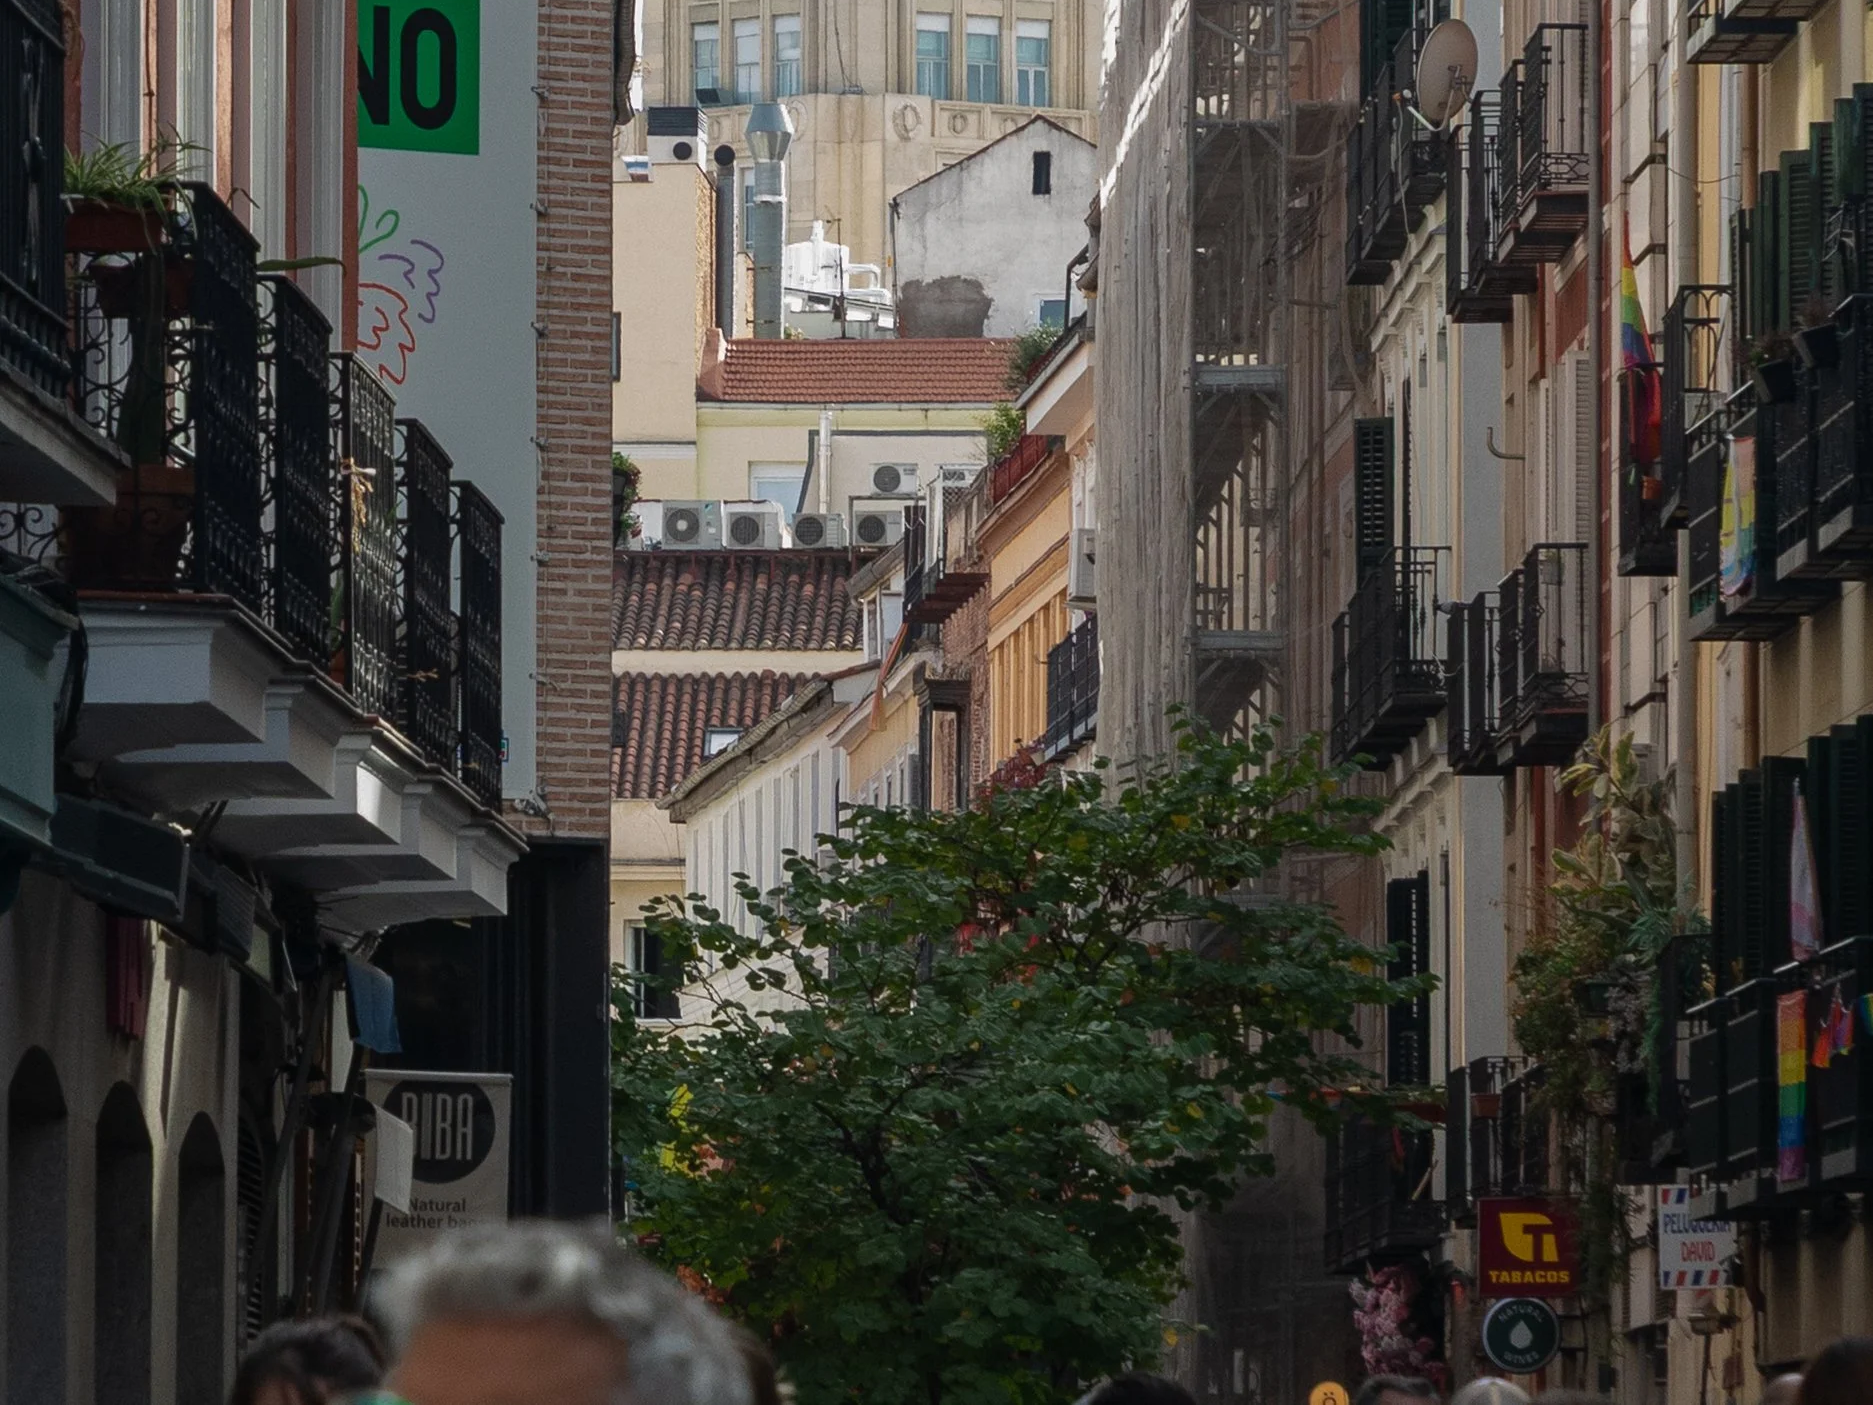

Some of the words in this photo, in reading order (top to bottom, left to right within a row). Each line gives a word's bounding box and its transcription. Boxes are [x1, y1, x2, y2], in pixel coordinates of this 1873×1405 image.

[401, 1091, 474, 1161] BIBA
[410, 1197, 467, 1212] Natural
[386, 1212, 444, 1229] leather
[1681, 1241, 1716, 1262] DAVID
[1488, 1270, 1570, 1284] TABACOS
[1497, 1304, 1545, 1323] NATURAL
[1503, 1350, 1540, 1364] WINES
